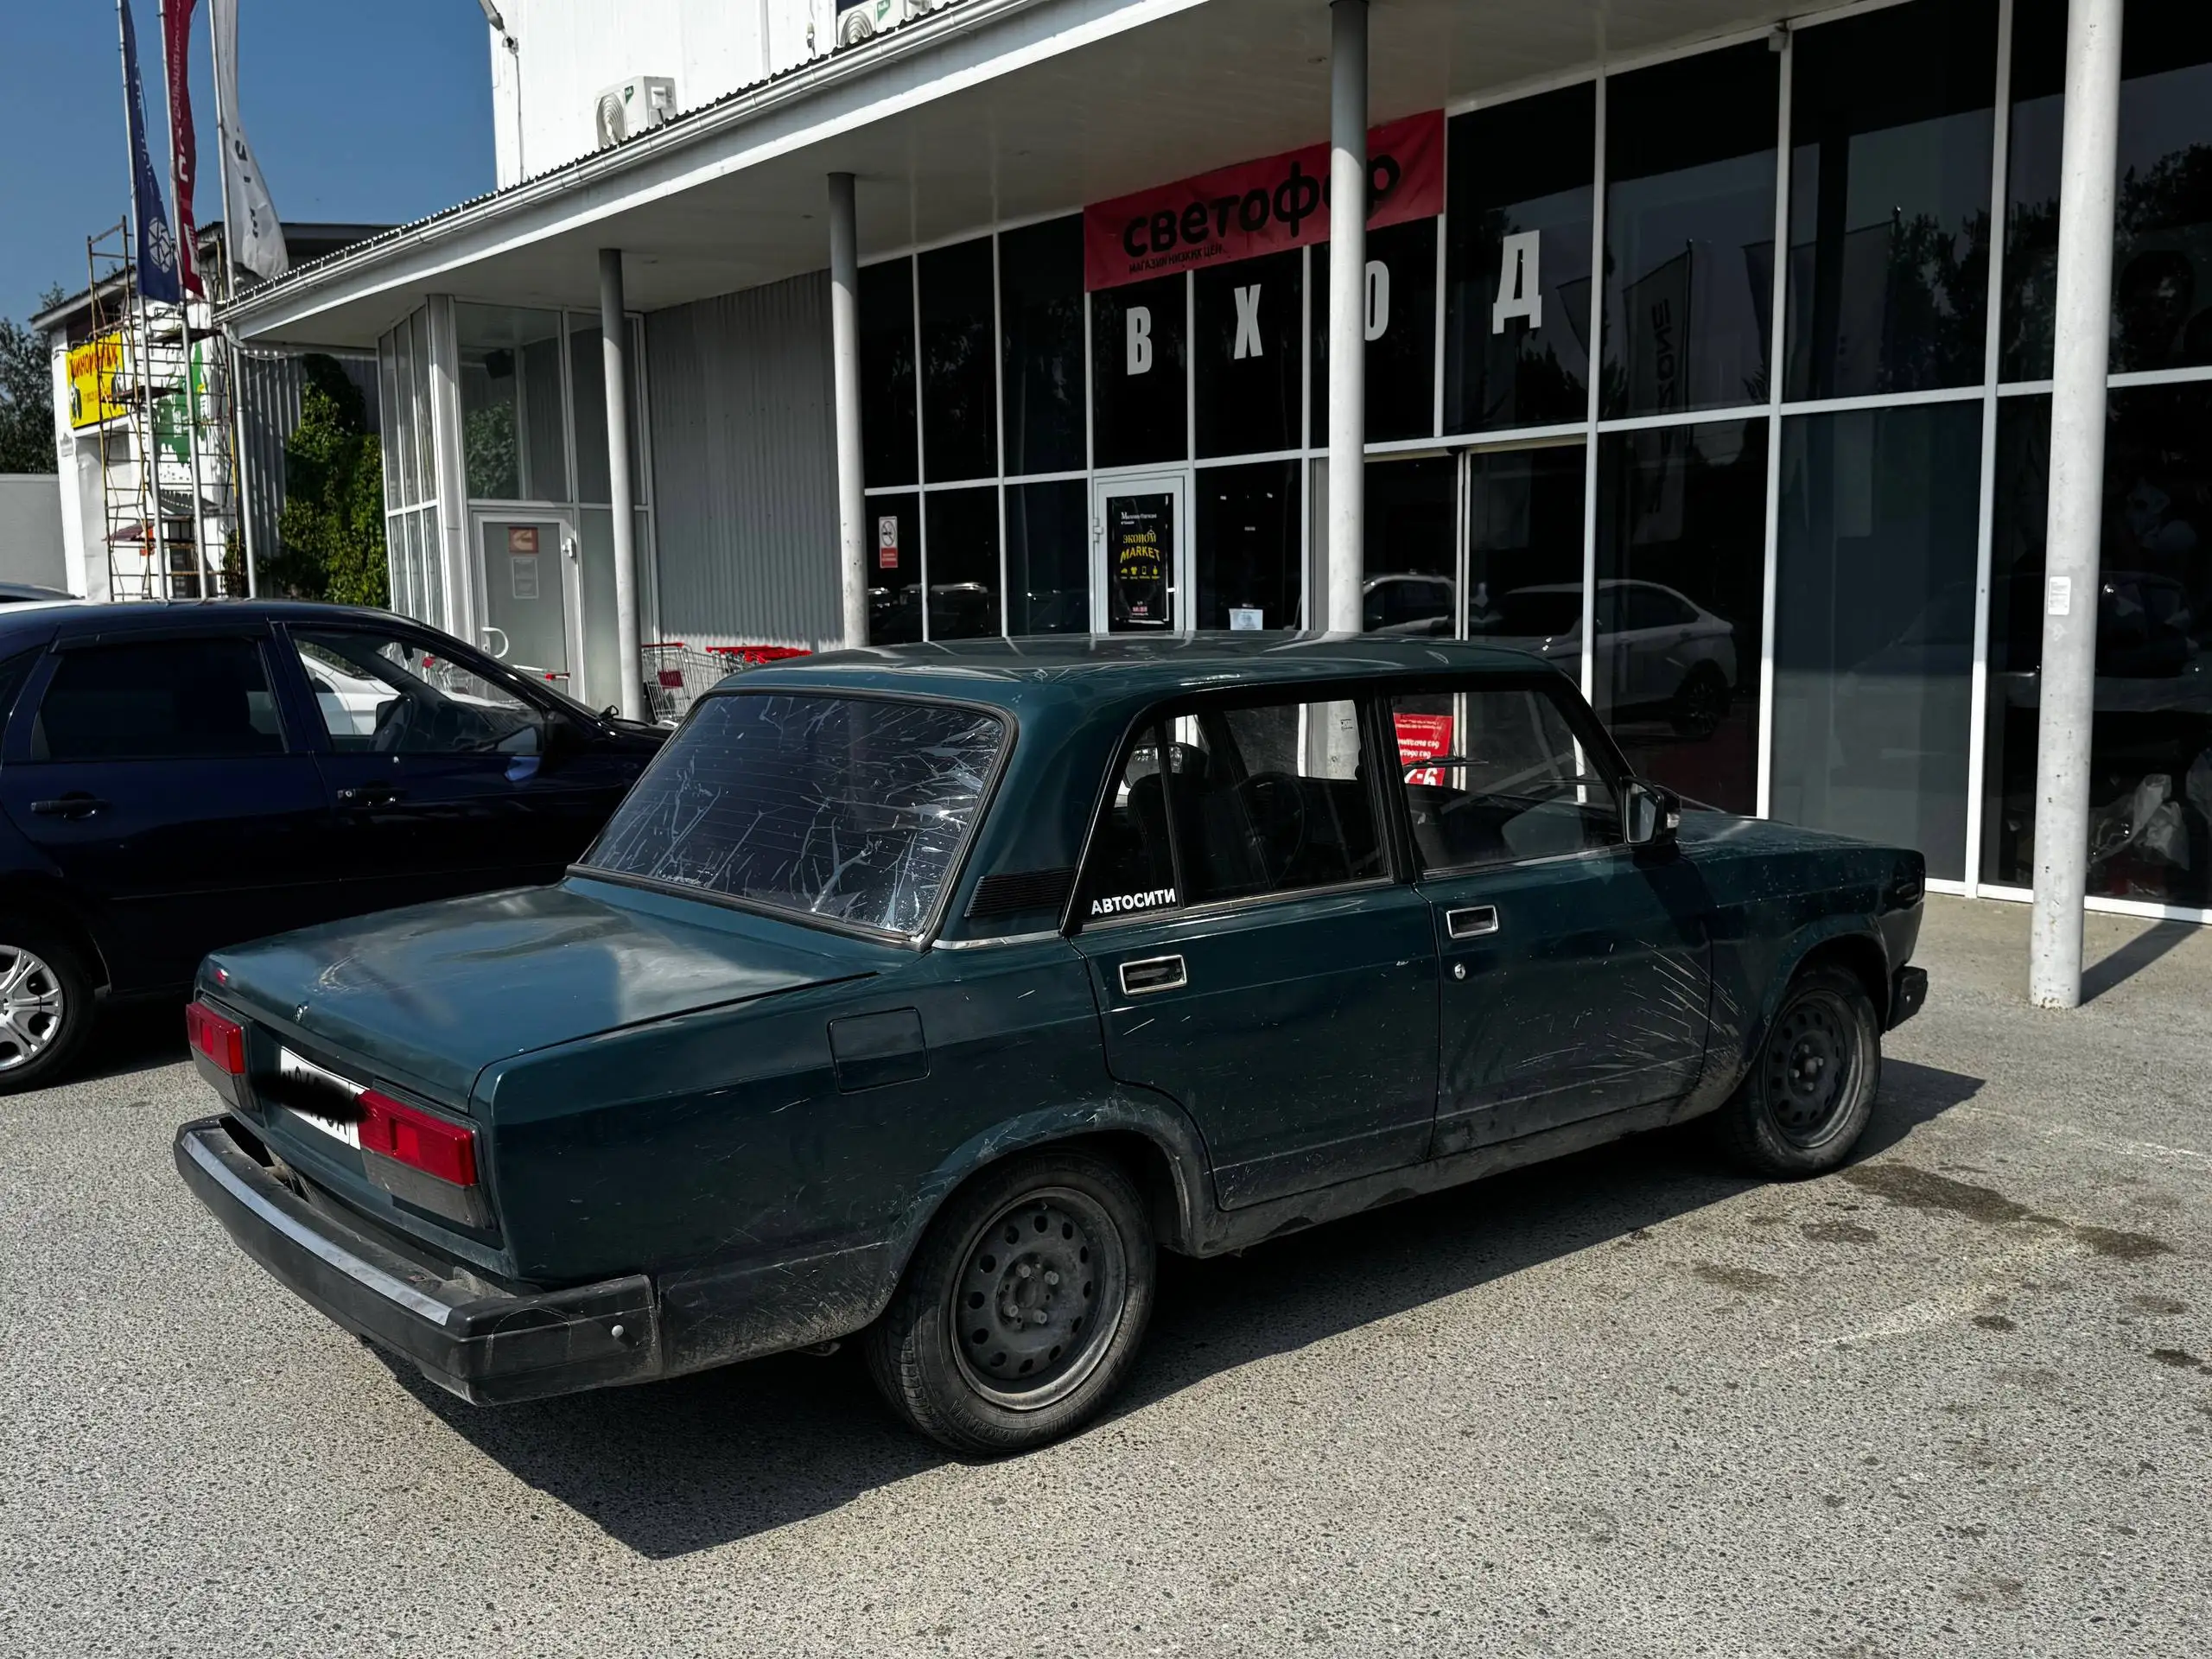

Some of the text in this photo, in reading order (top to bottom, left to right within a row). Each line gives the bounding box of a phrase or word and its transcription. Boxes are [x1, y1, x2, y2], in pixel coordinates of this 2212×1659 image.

[1123, 154, 1401, 257] светофр
[1120, 546, 1160, 563] MARKET
[1090, 887, 1177, 916] АВТОСИТИ
